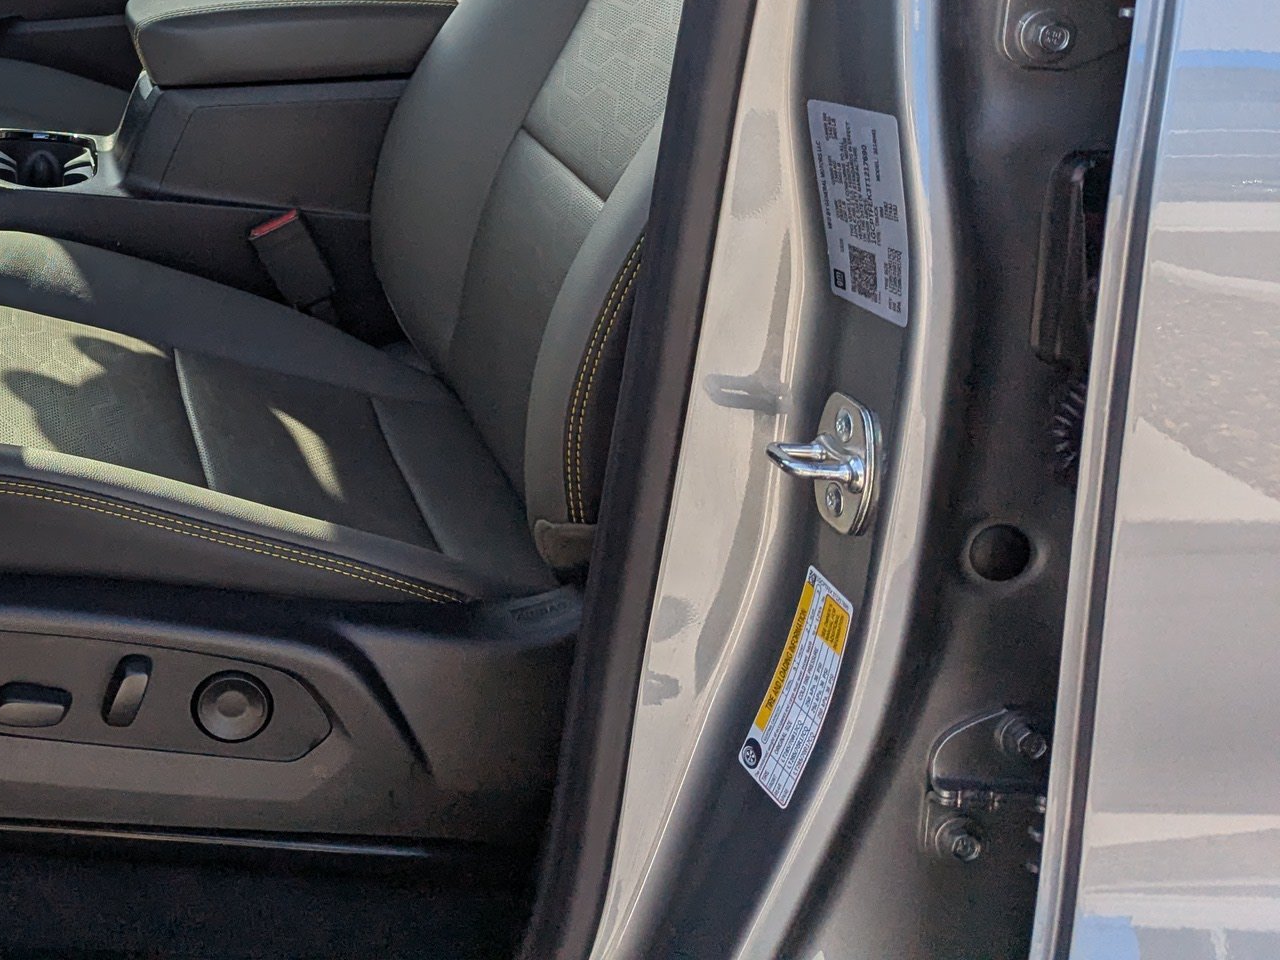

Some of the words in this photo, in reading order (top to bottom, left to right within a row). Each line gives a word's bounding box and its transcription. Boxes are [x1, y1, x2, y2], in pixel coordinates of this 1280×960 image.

[816, 151, 826, 178] MOTORS
[820, 178, 830, 208] GENERAL
[764, 694, 775, 713] TIRE
[770, 677, 782, 698] AND
[776, 649, 793, 683] LOADING
[787, 606, 807, 654] INFORMATION
